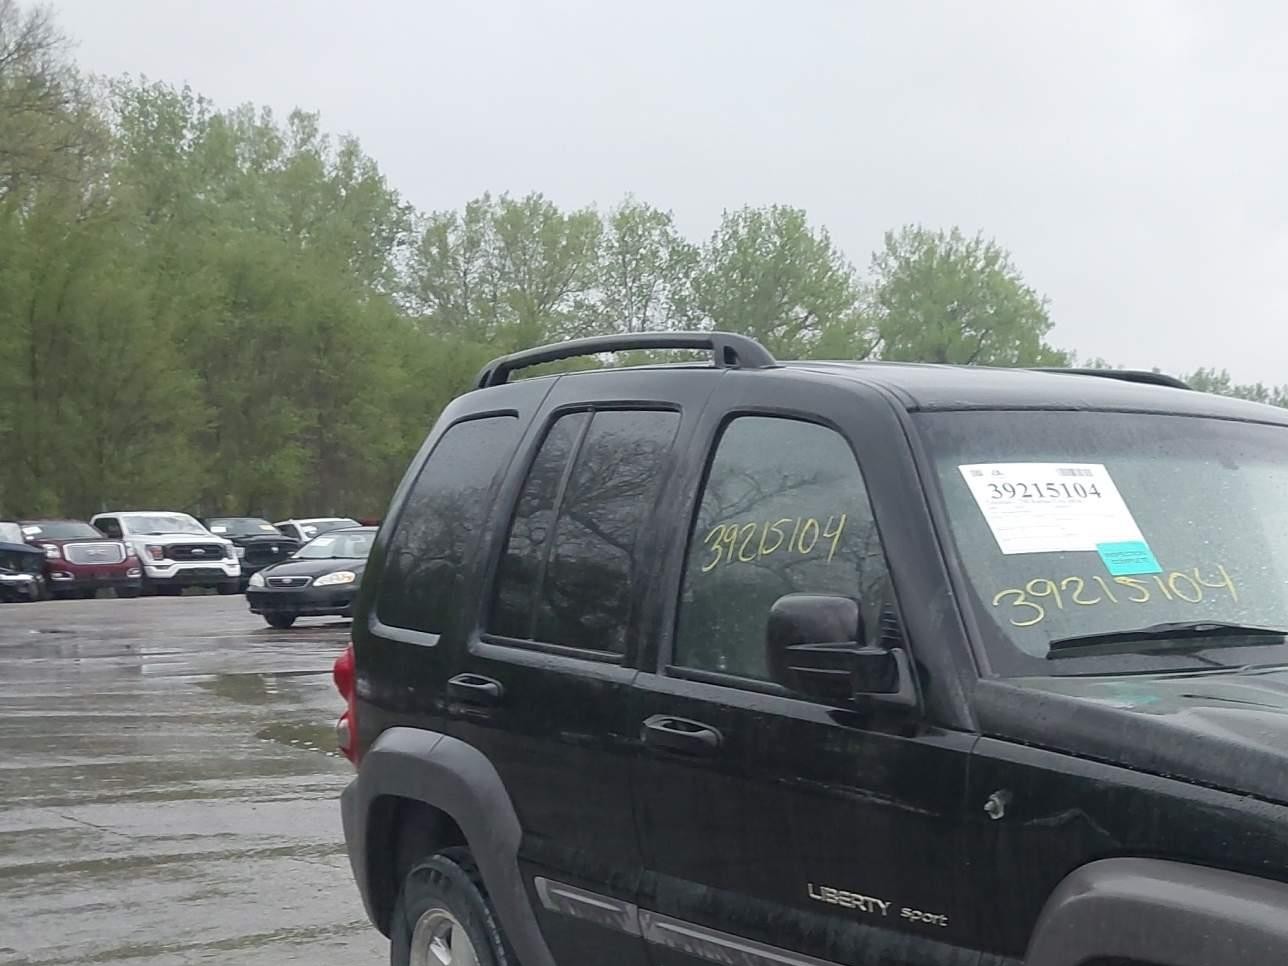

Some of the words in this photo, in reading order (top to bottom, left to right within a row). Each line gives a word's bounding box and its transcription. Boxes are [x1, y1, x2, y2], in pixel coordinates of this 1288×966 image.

[987, 482, 1102, 499] 39215104
[702, 514, 847, 573] 39215104
[992, 565, 1239, 627] 39215104
[807, 883, 892, 916] LIBERTY
